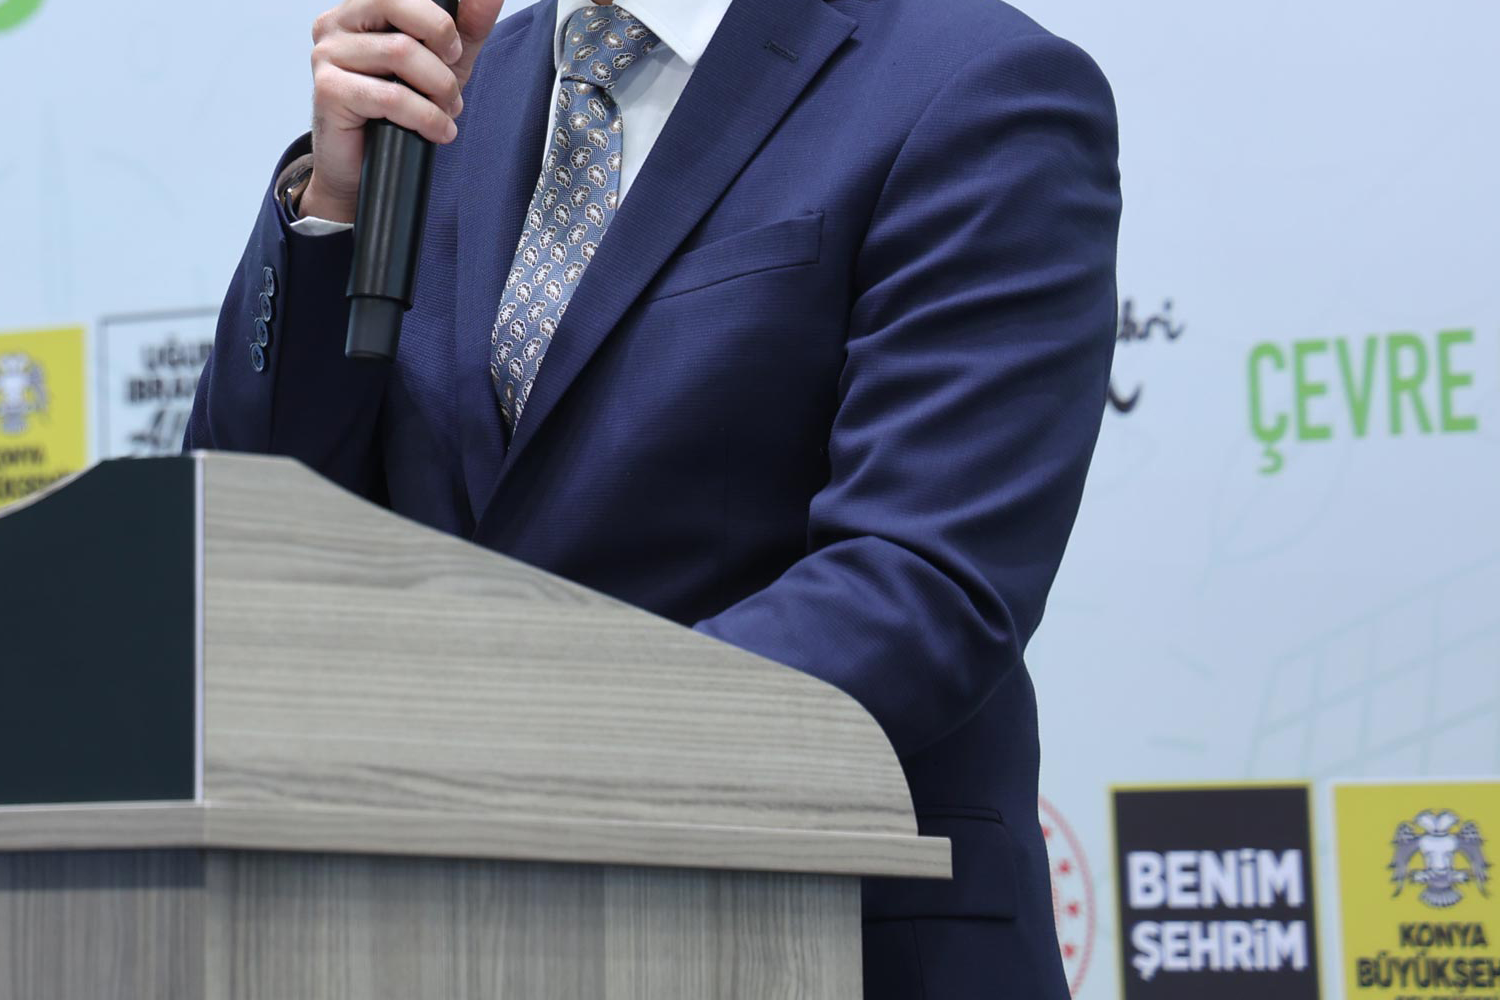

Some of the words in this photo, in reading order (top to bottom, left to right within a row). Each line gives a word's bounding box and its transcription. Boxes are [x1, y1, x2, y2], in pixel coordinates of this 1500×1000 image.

[1248, 328, 1478, 476] ÇEVRE
[1127, 848, 1304, 909] BENİM
[1131, 919, 1308, 981] ŞEHRİM
[1399, 922, 1487, 947] KONYA
